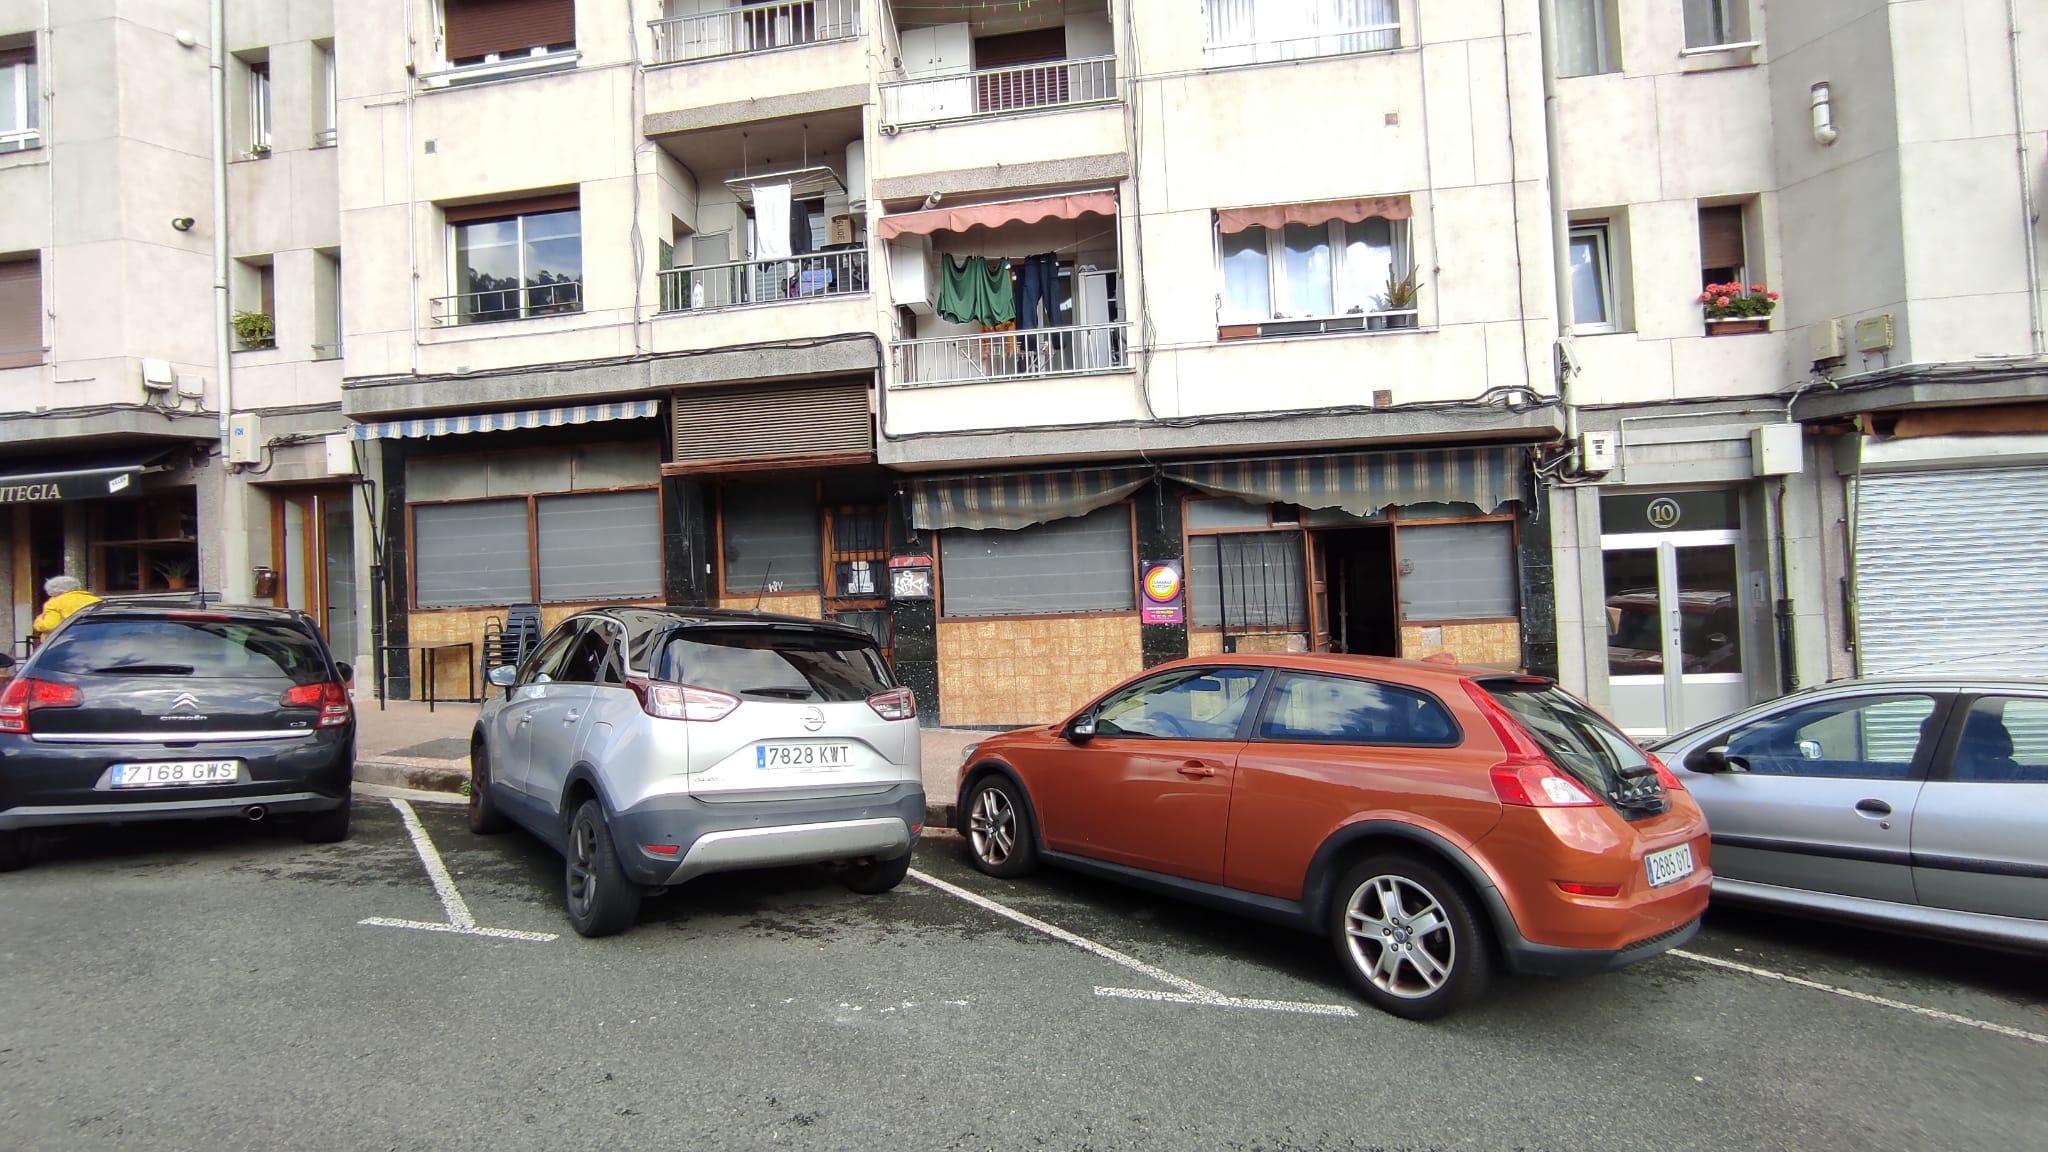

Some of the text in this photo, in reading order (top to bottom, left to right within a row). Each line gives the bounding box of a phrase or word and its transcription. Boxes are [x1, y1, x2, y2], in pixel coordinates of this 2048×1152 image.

[0, 484, 61, 502] ITEGIA
[1653, 504, 1674, 522] 10
[769, 746, 849, 766] 7828 KWT
[127, 763, 232, 782] 7168 GWS
[1653, 848, 1691, 879] 2685 GYZ
